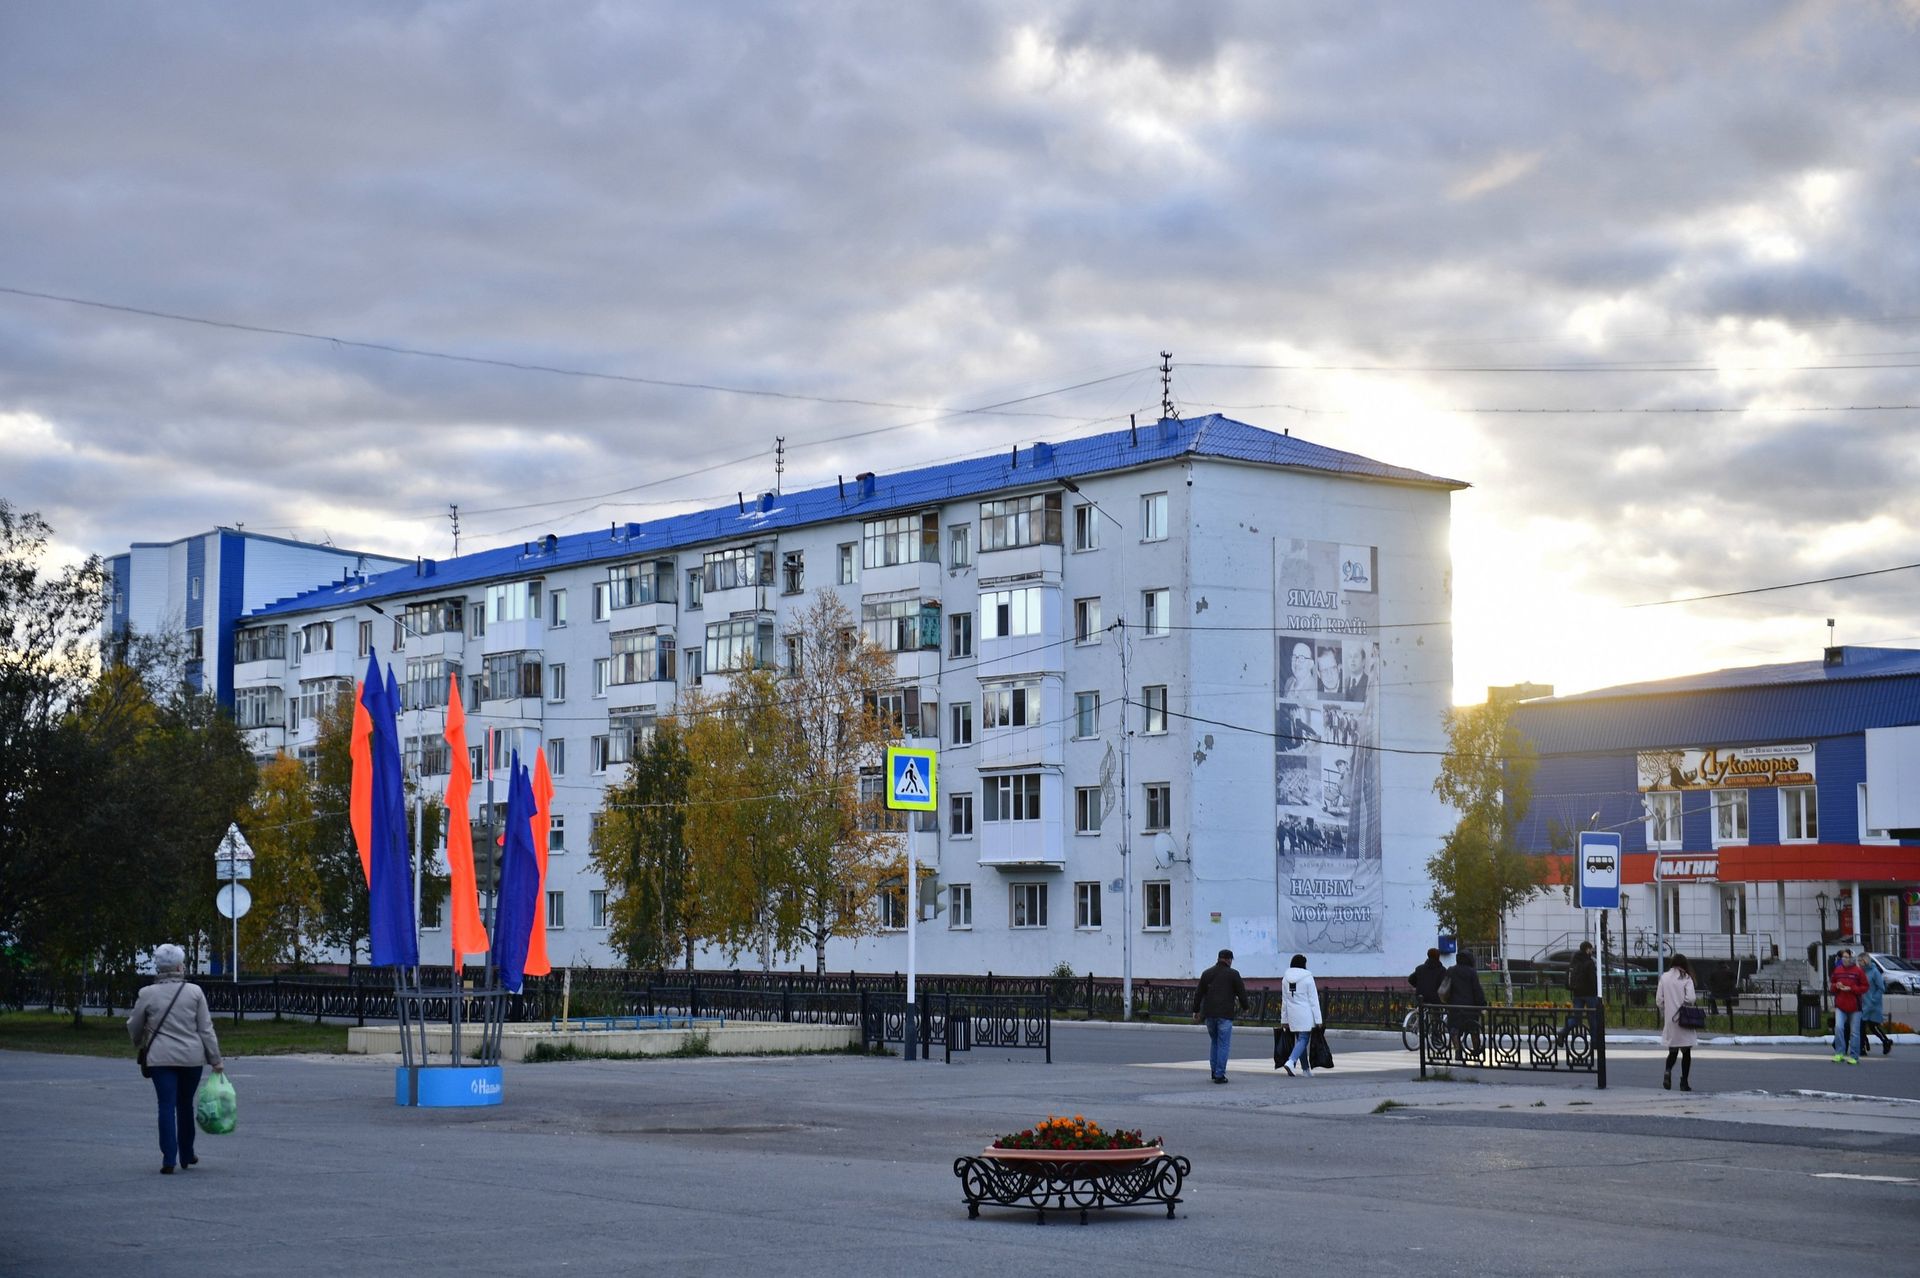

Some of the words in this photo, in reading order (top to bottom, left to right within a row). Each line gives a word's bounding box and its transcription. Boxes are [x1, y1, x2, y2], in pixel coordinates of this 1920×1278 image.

[1287, 588, 1337, 609] ЯМАЛ
[1287, 613, 1321, 632] МОЙ
[1326, 617, 1368, 635] КРАЙ!
[1699, 747, 1799, 785] Лукоморье
[1290, 878, 1353, 899] НАДЫМ
[1291, 902, 1328, 921] МОЙ
[1332, 906, 1371, 924] ДОМ!
